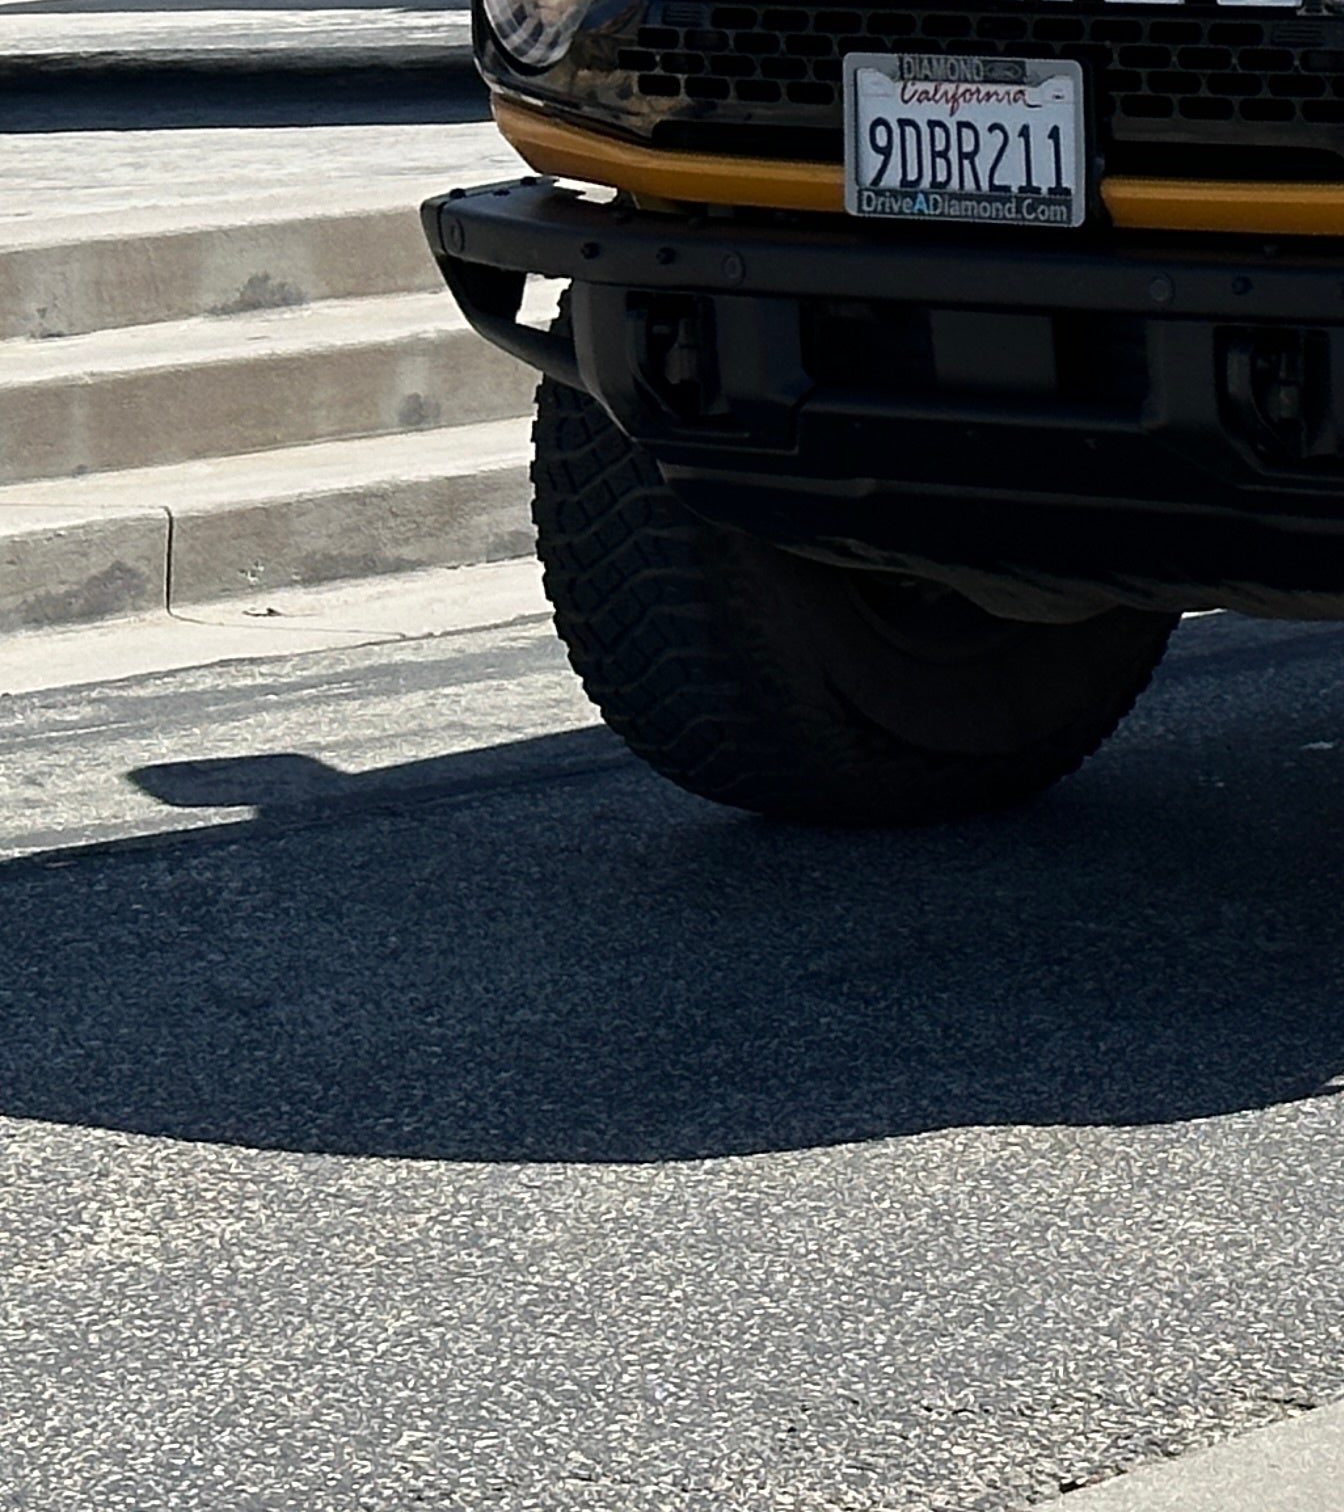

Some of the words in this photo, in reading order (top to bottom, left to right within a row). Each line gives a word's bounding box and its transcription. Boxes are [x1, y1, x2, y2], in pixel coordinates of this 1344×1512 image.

[902, 56, 984, 81] DIAMOND
[900, 80, 1042, 116] California
[869, 117, 1072, 196] 9DBR211
[861, 190, 1068, 221] DriveADiamond.Com
